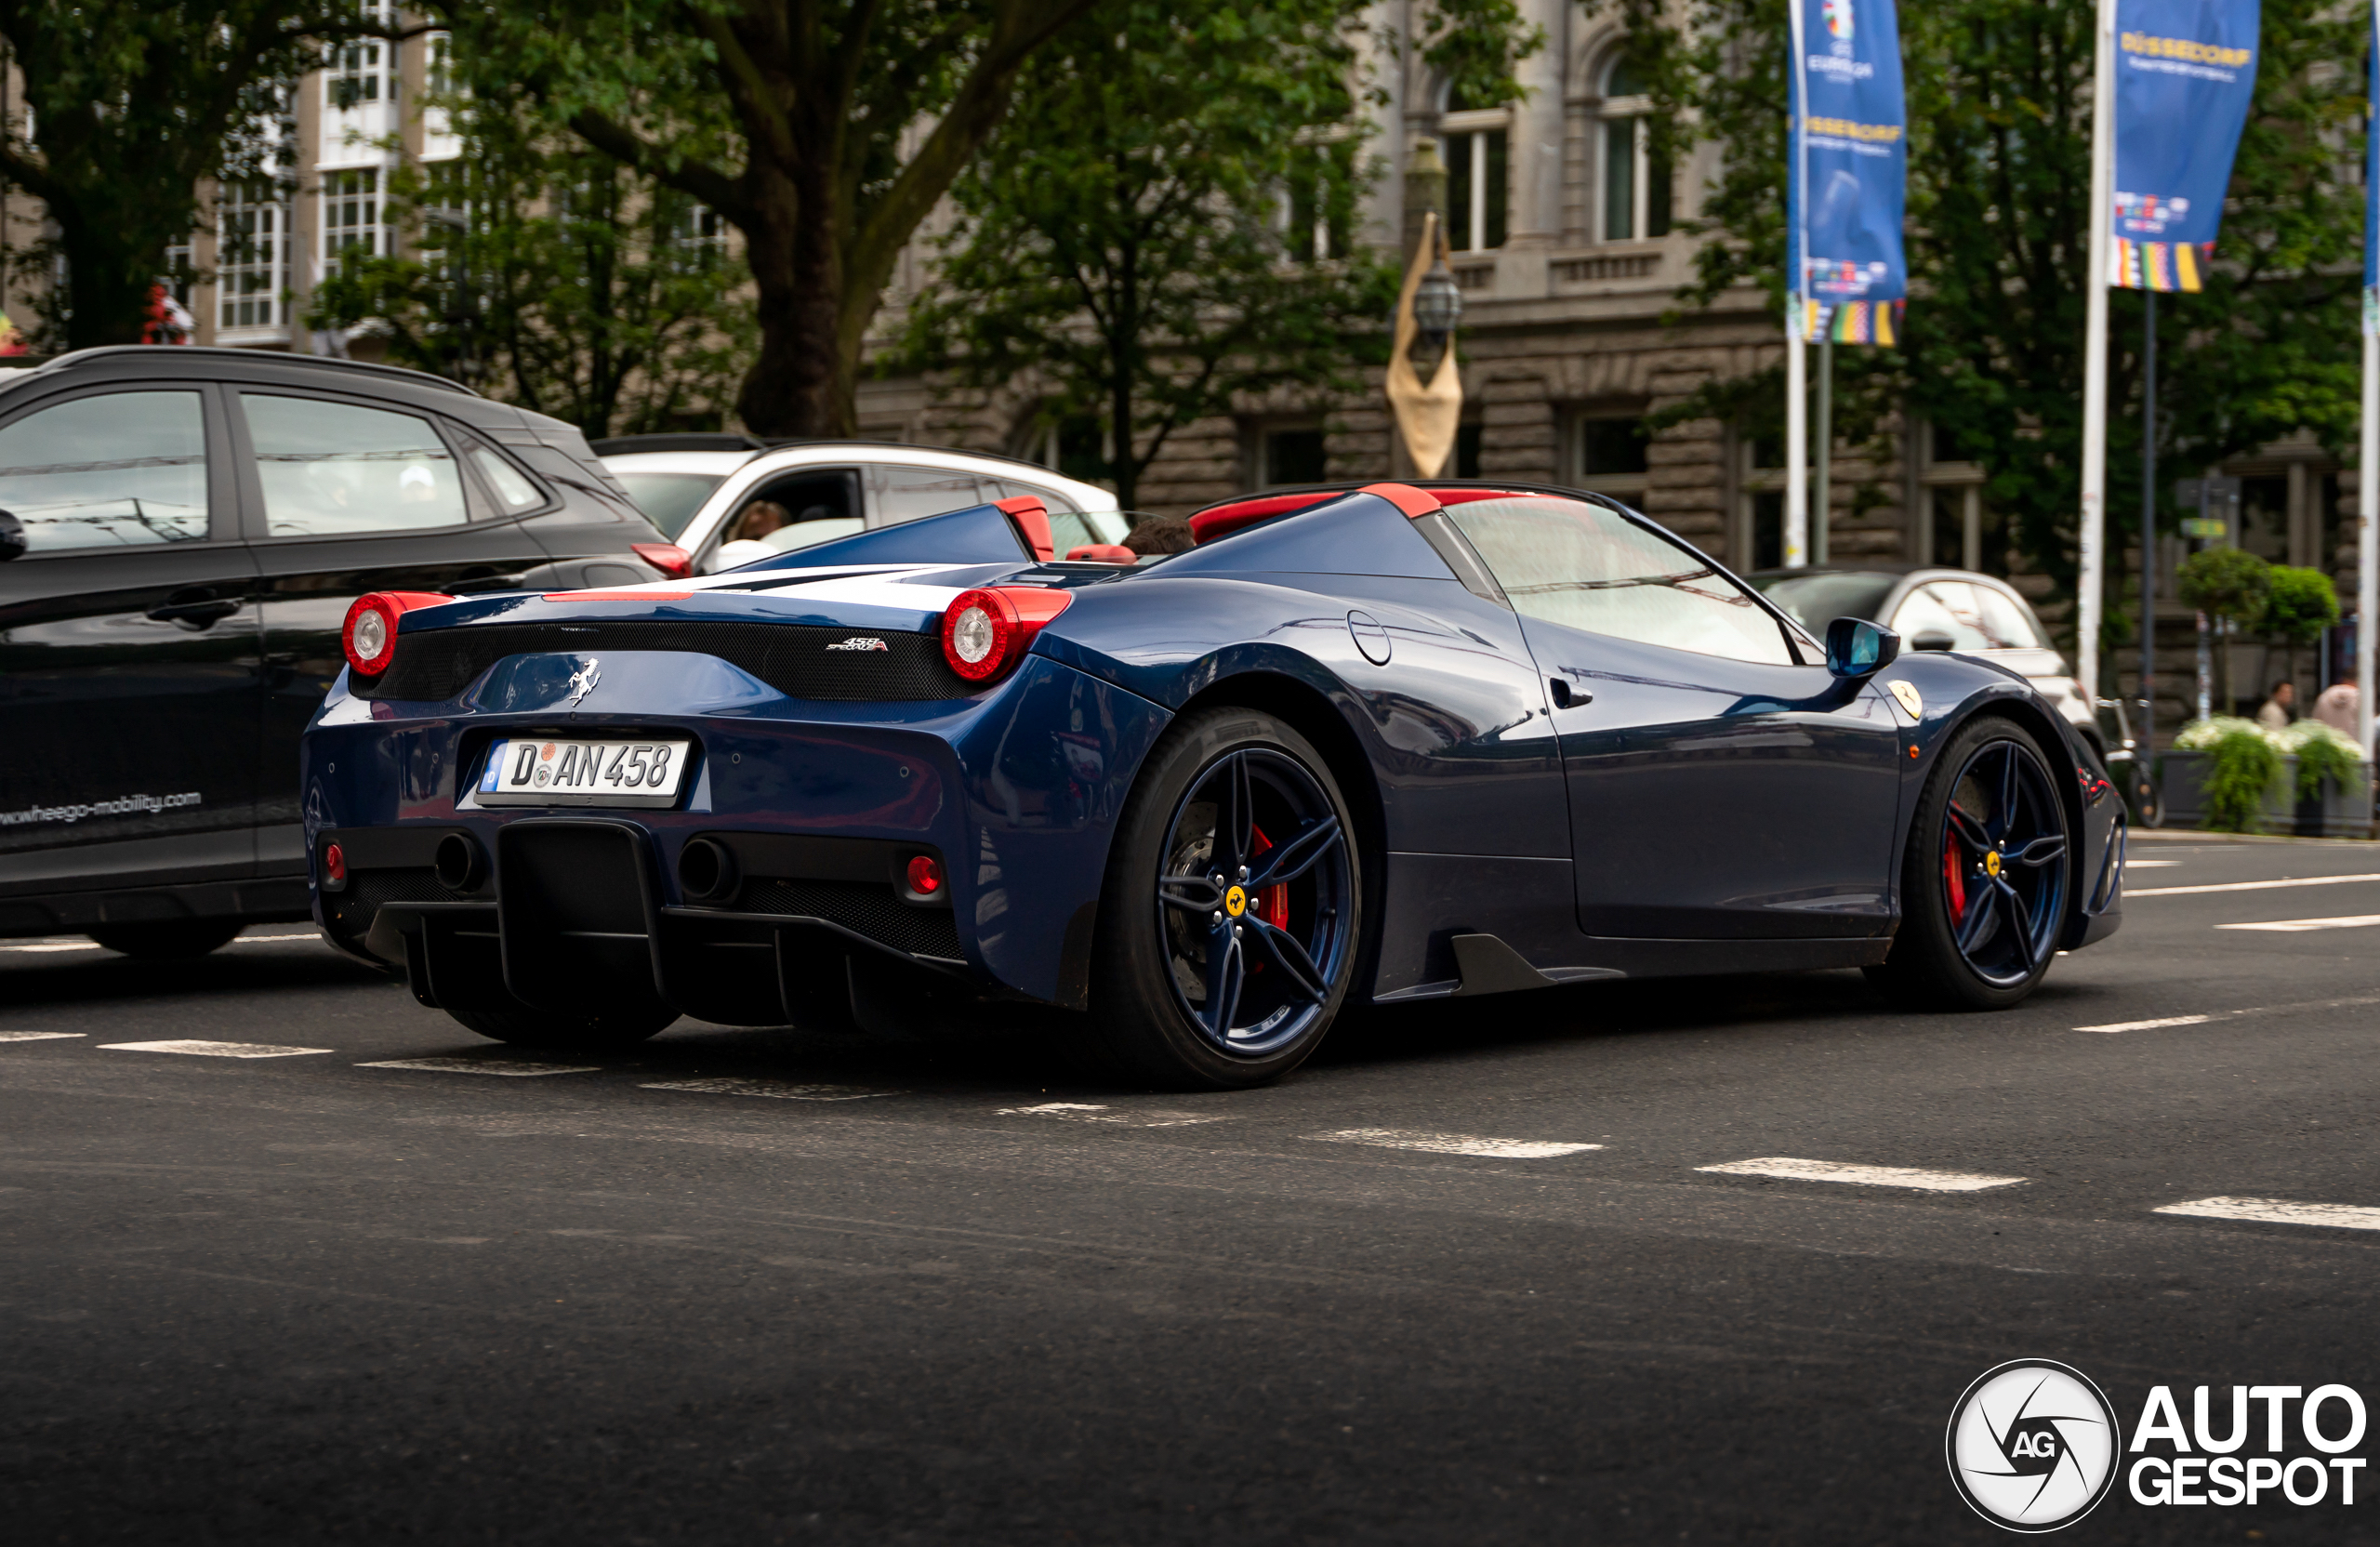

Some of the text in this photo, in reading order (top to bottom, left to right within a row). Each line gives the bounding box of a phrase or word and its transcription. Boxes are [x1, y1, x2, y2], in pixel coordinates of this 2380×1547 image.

[511, 745, 672, 787] D AN 458
